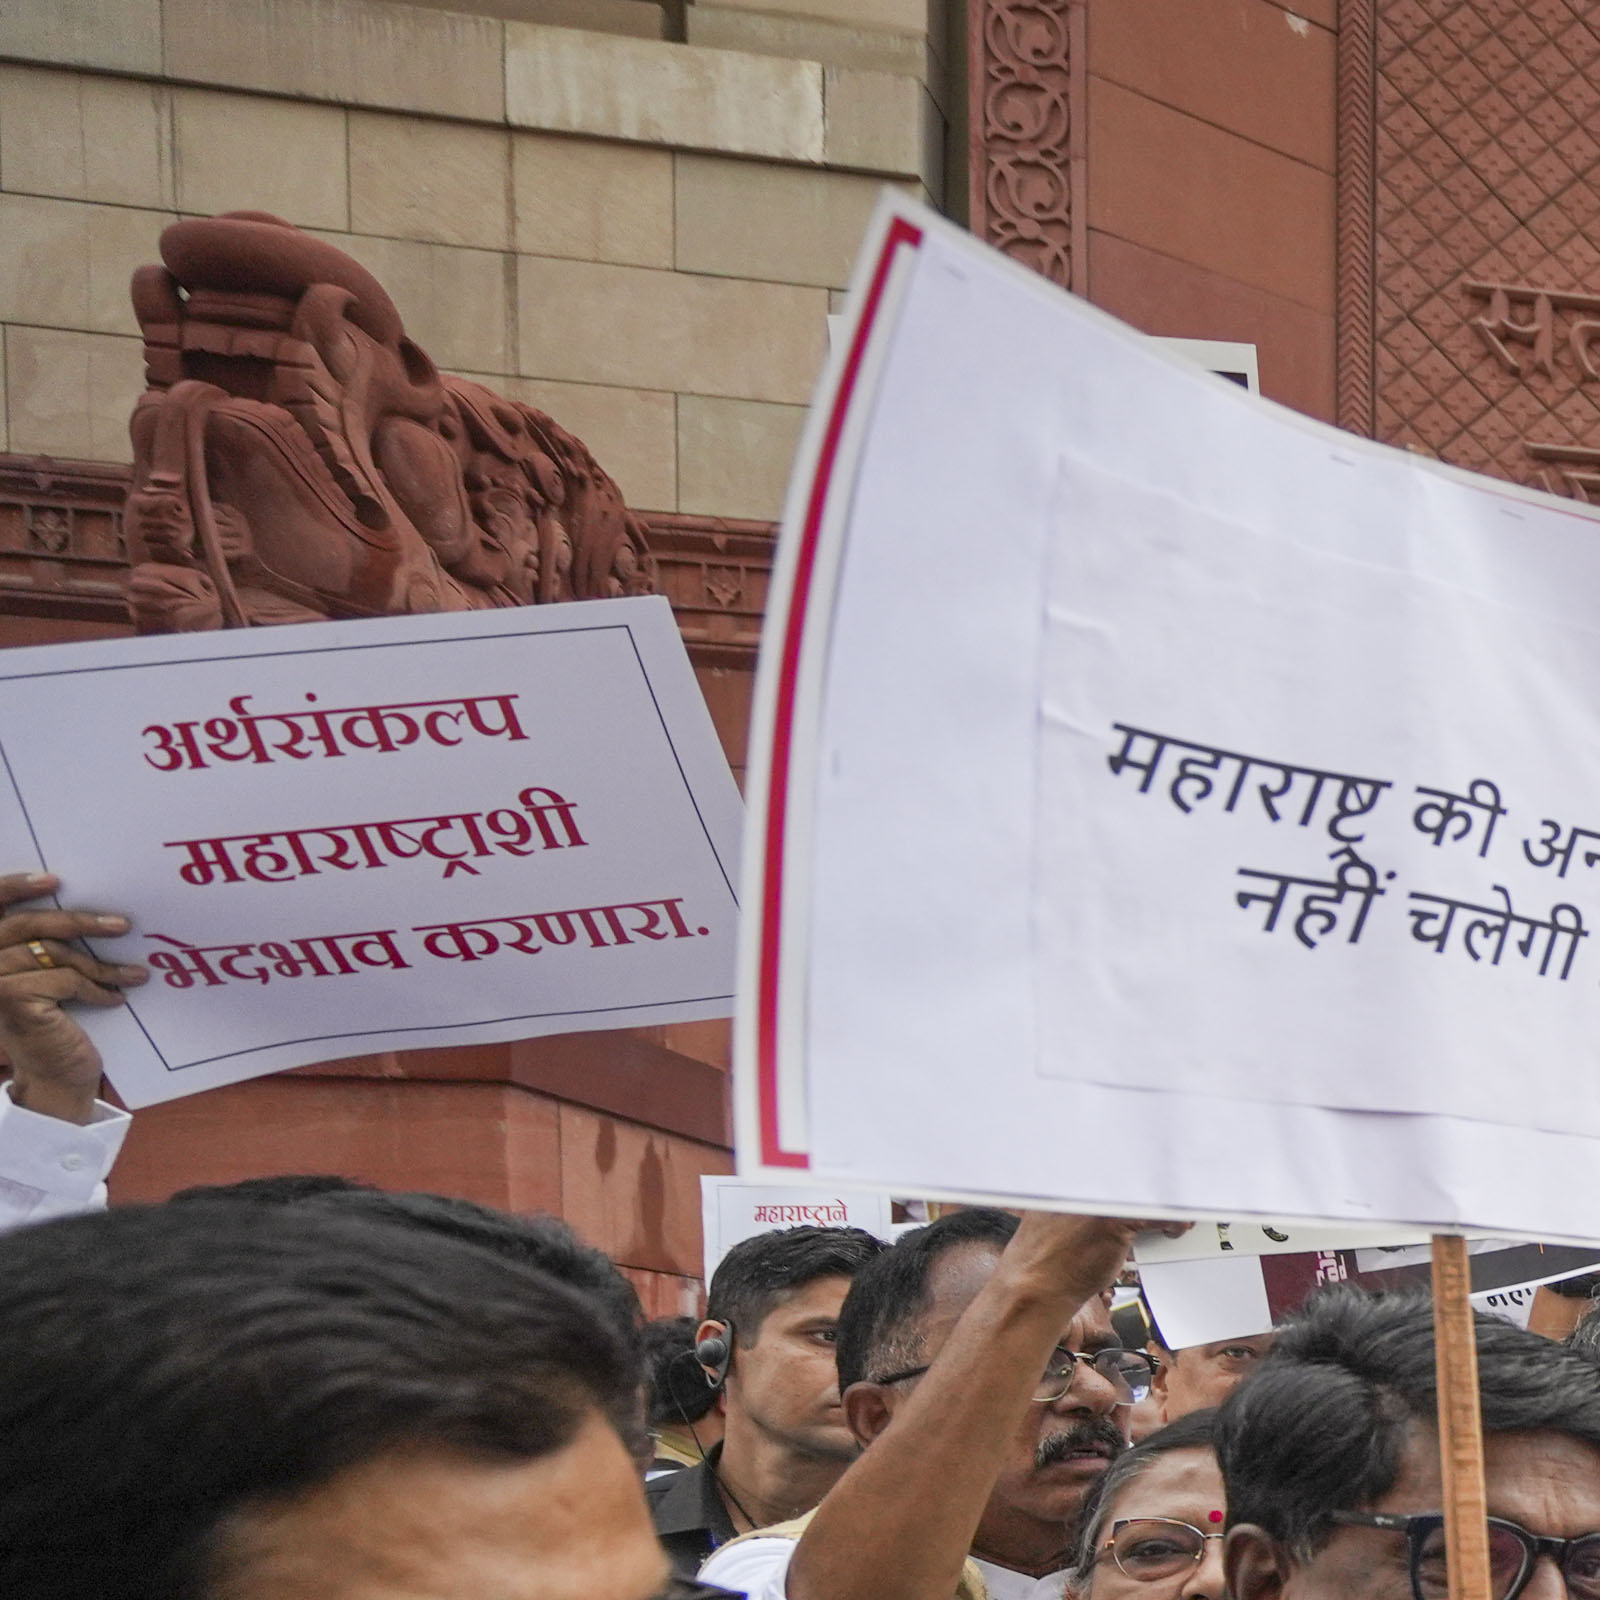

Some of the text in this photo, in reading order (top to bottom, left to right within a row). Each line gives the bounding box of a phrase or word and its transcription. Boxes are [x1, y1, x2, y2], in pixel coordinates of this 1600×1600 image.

[141, 692, 529, 773] अर्थसंकल्प
[163, 787, 589, 886] महाराष्ट्राशी
[1107, 722, 1393, 862] महाराष्ट्र
[1411, 779, 1506, 858] की
[144, 898, 710, 990] भेदभाव करणारा.
[1235, 848, 1398, 949] नहीं
[1408, 885, 1587, 981] चलेगी
